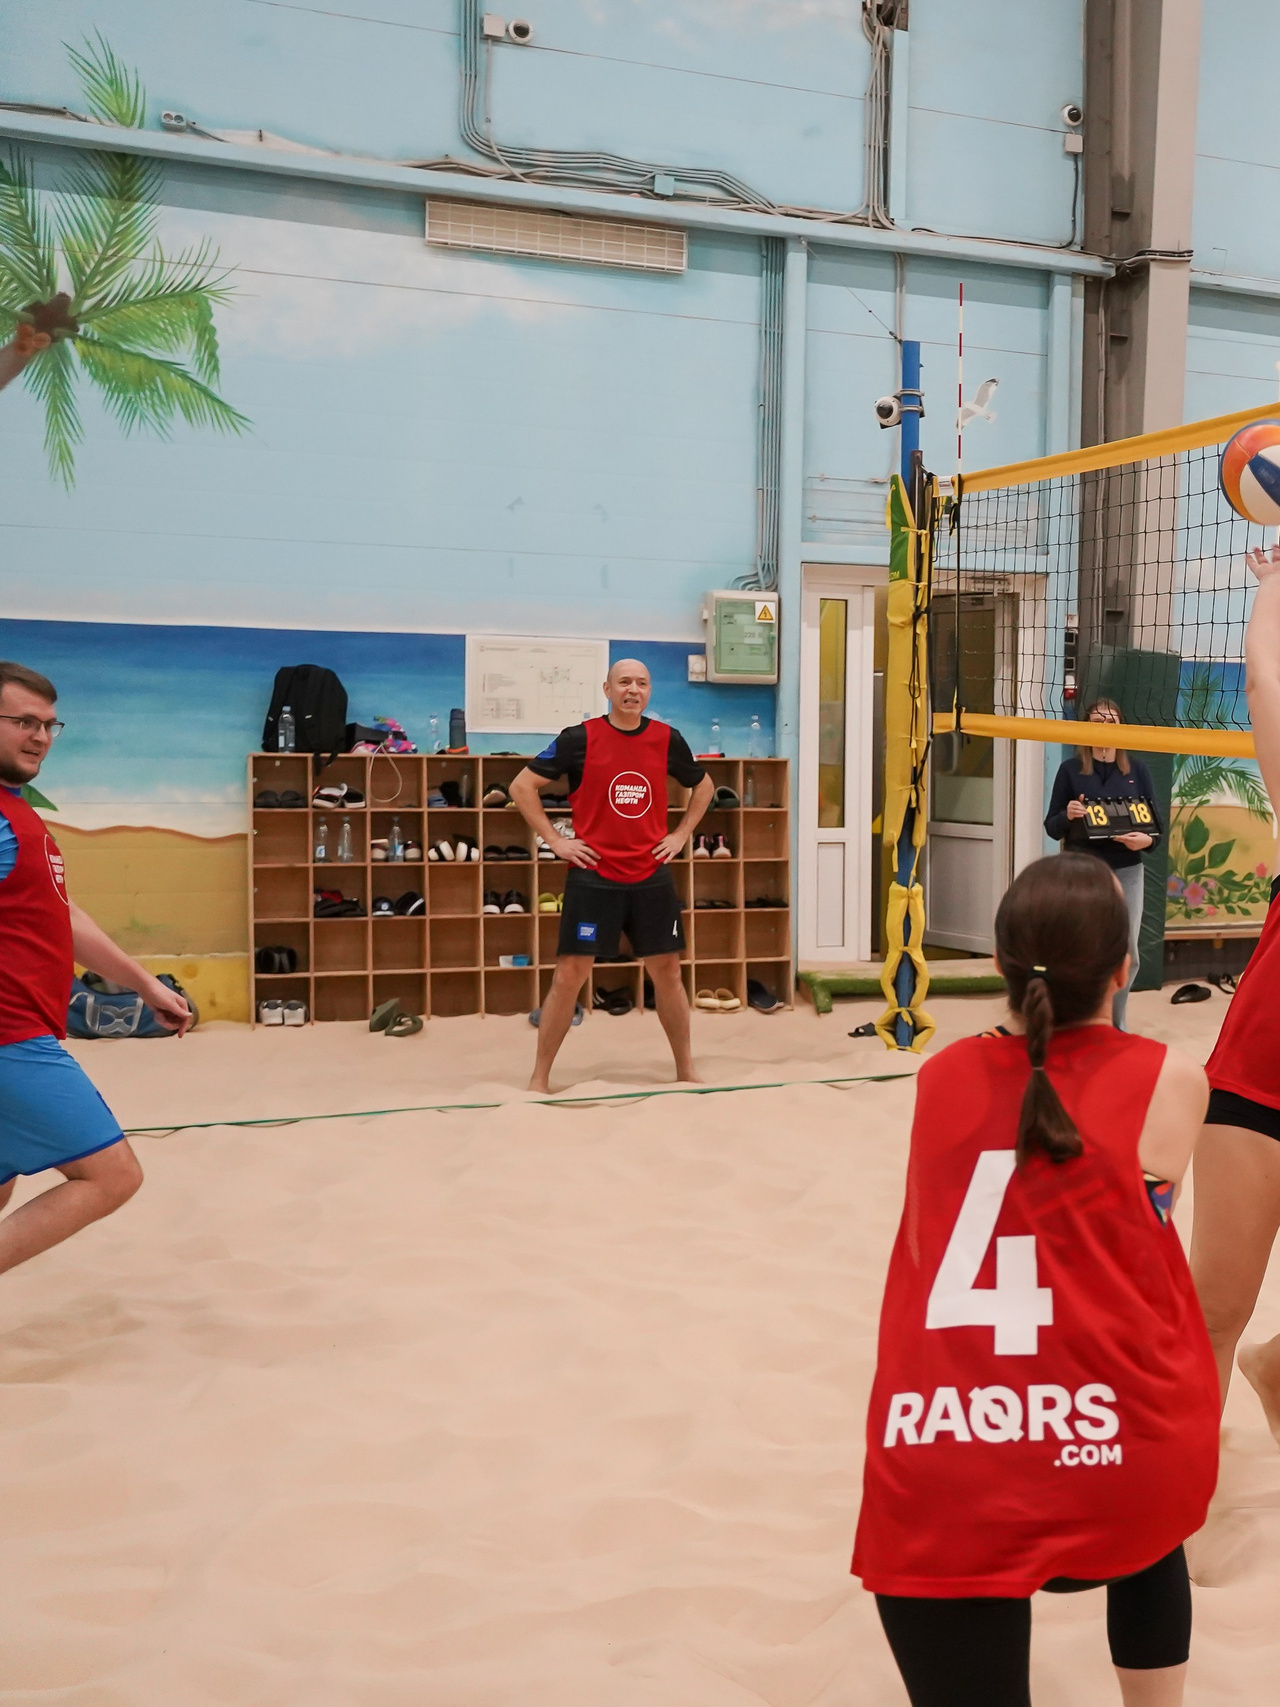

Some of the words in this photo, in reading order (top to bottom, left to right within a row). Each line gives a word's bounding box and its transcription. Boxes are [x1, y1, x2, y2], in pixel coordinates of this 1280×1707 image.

[615, 785, 647, 793] КОМАНДА
[615, 791, 645, 799] ГАЗПРОМ
[1086, 805, 1108, 826] 13
[1129, 803, 1151, 823] 18
[925, 1149, 1053, 1355] 4
[1054, 1445, 1123, 1466] .COM
